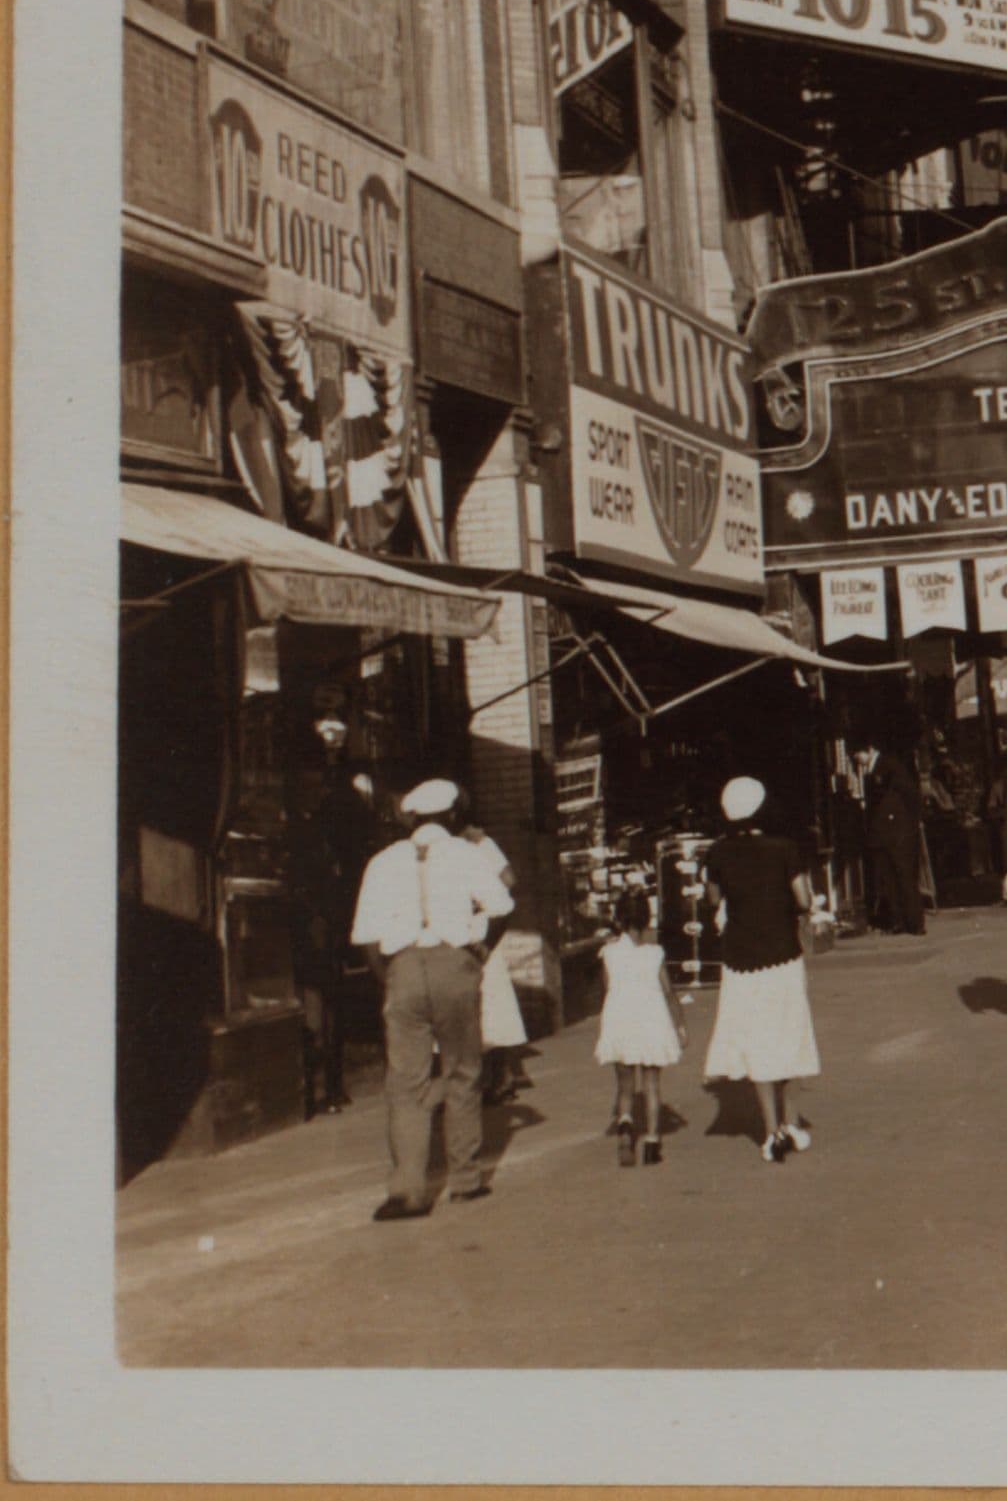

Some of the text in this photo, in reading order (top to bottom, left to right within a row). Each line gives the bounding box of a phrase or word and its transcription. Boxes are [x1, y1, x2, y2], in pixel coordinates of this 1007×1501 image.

[277, 131, 347, 205] REED
[261, 195, 367, 300] CLOTHES
[571, 260, 750, 442] TRUNKS
[587, 419, 631, 471] SPORT
[588, 476, 635, 525] WEAR
